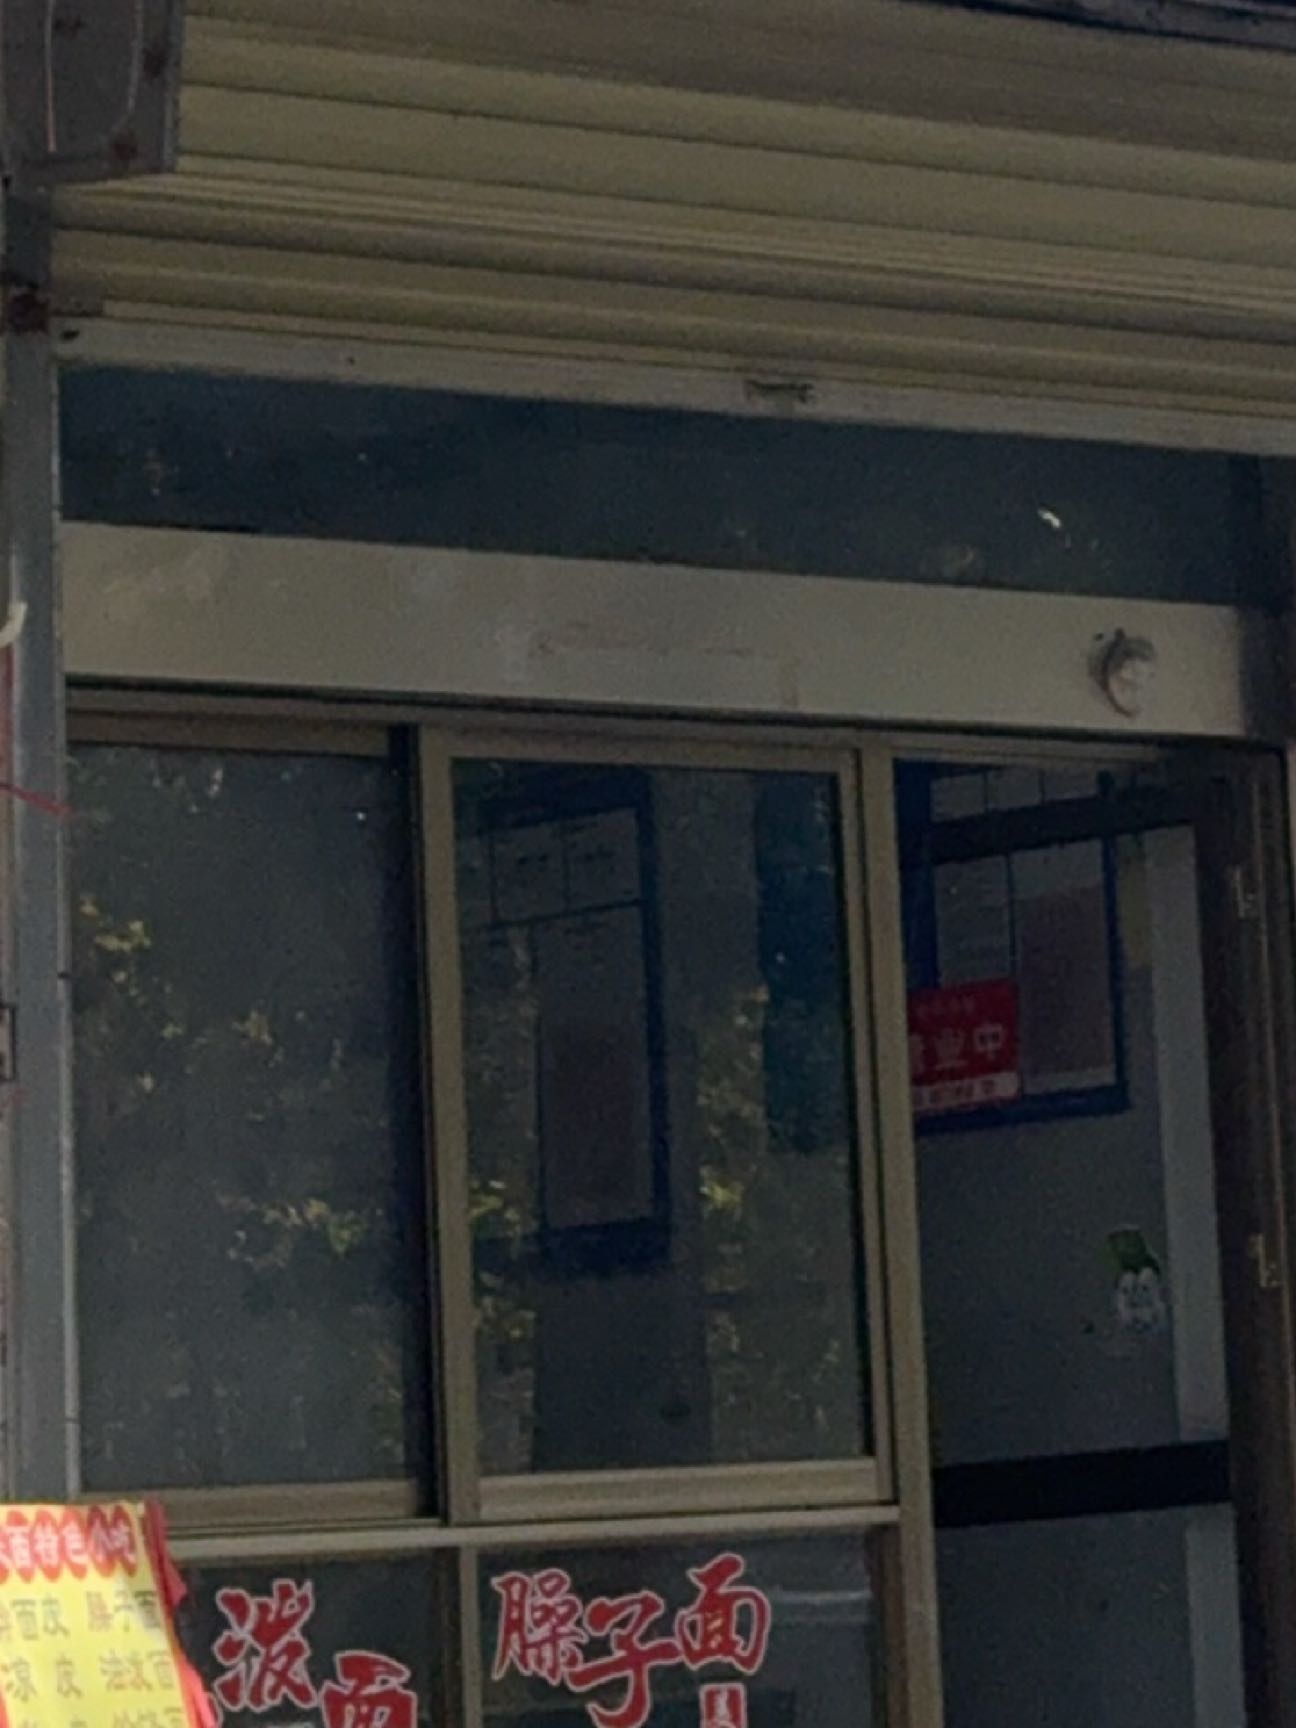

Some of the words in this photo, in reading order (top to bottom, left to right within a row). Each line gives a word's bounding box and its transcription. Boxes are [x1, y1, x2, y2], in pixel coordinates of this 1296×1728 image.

[210, 1579, 417, 1728] 泼面
[491, 1553, 771, 1728] 臊子面
